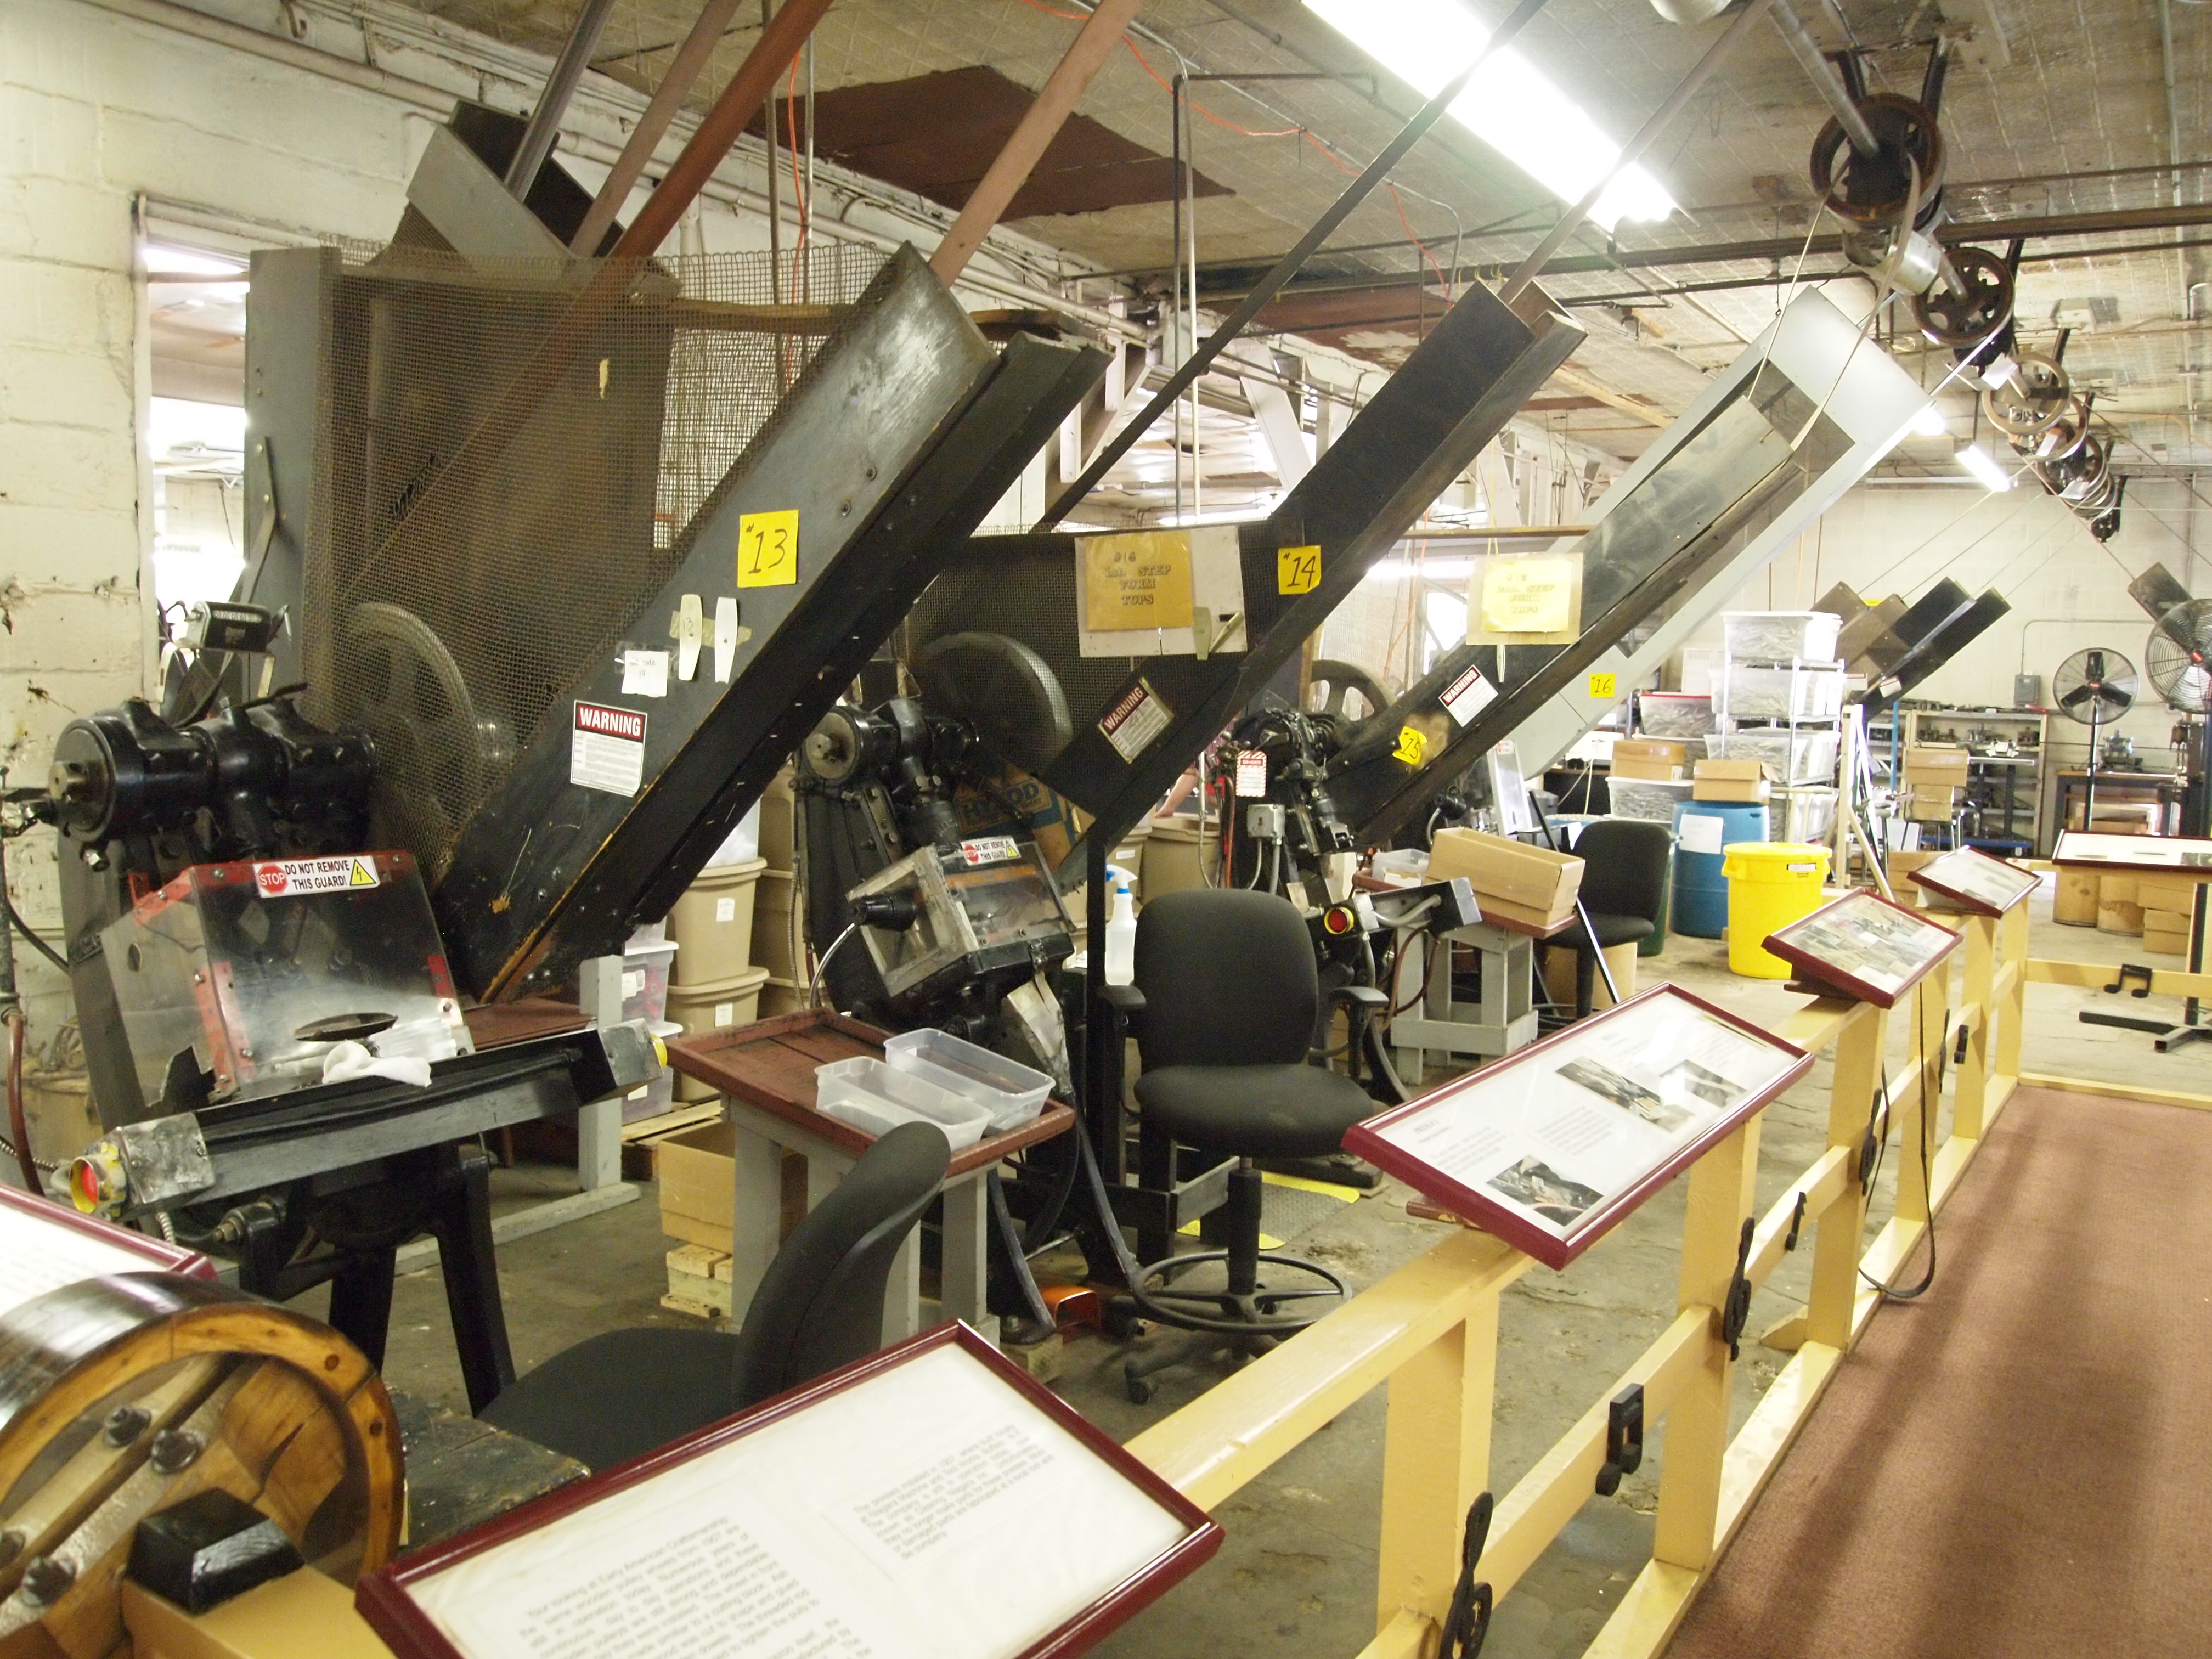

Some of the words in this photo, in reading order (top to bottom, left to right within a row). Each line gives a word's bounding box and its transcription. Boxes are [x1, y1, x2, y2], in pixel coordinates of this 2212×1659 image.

[746, 522, 788, 574] #13
[1283, 552, 1316, 588] #14
[1442, 669, 1478, 703] WARNING
[580, 707, 641, 736] WARNING
[1104, 687, 1144, 730] WARNING
[260, 872, 285, 886] STOP
[284, 864, 297, 876] DO
[298, 863, 314, 874] NOT
[318, 860, 350, 873] REMOVE
[292, 878, 313, 890] THIS
[314, 876, 348, 888] GUARD!
